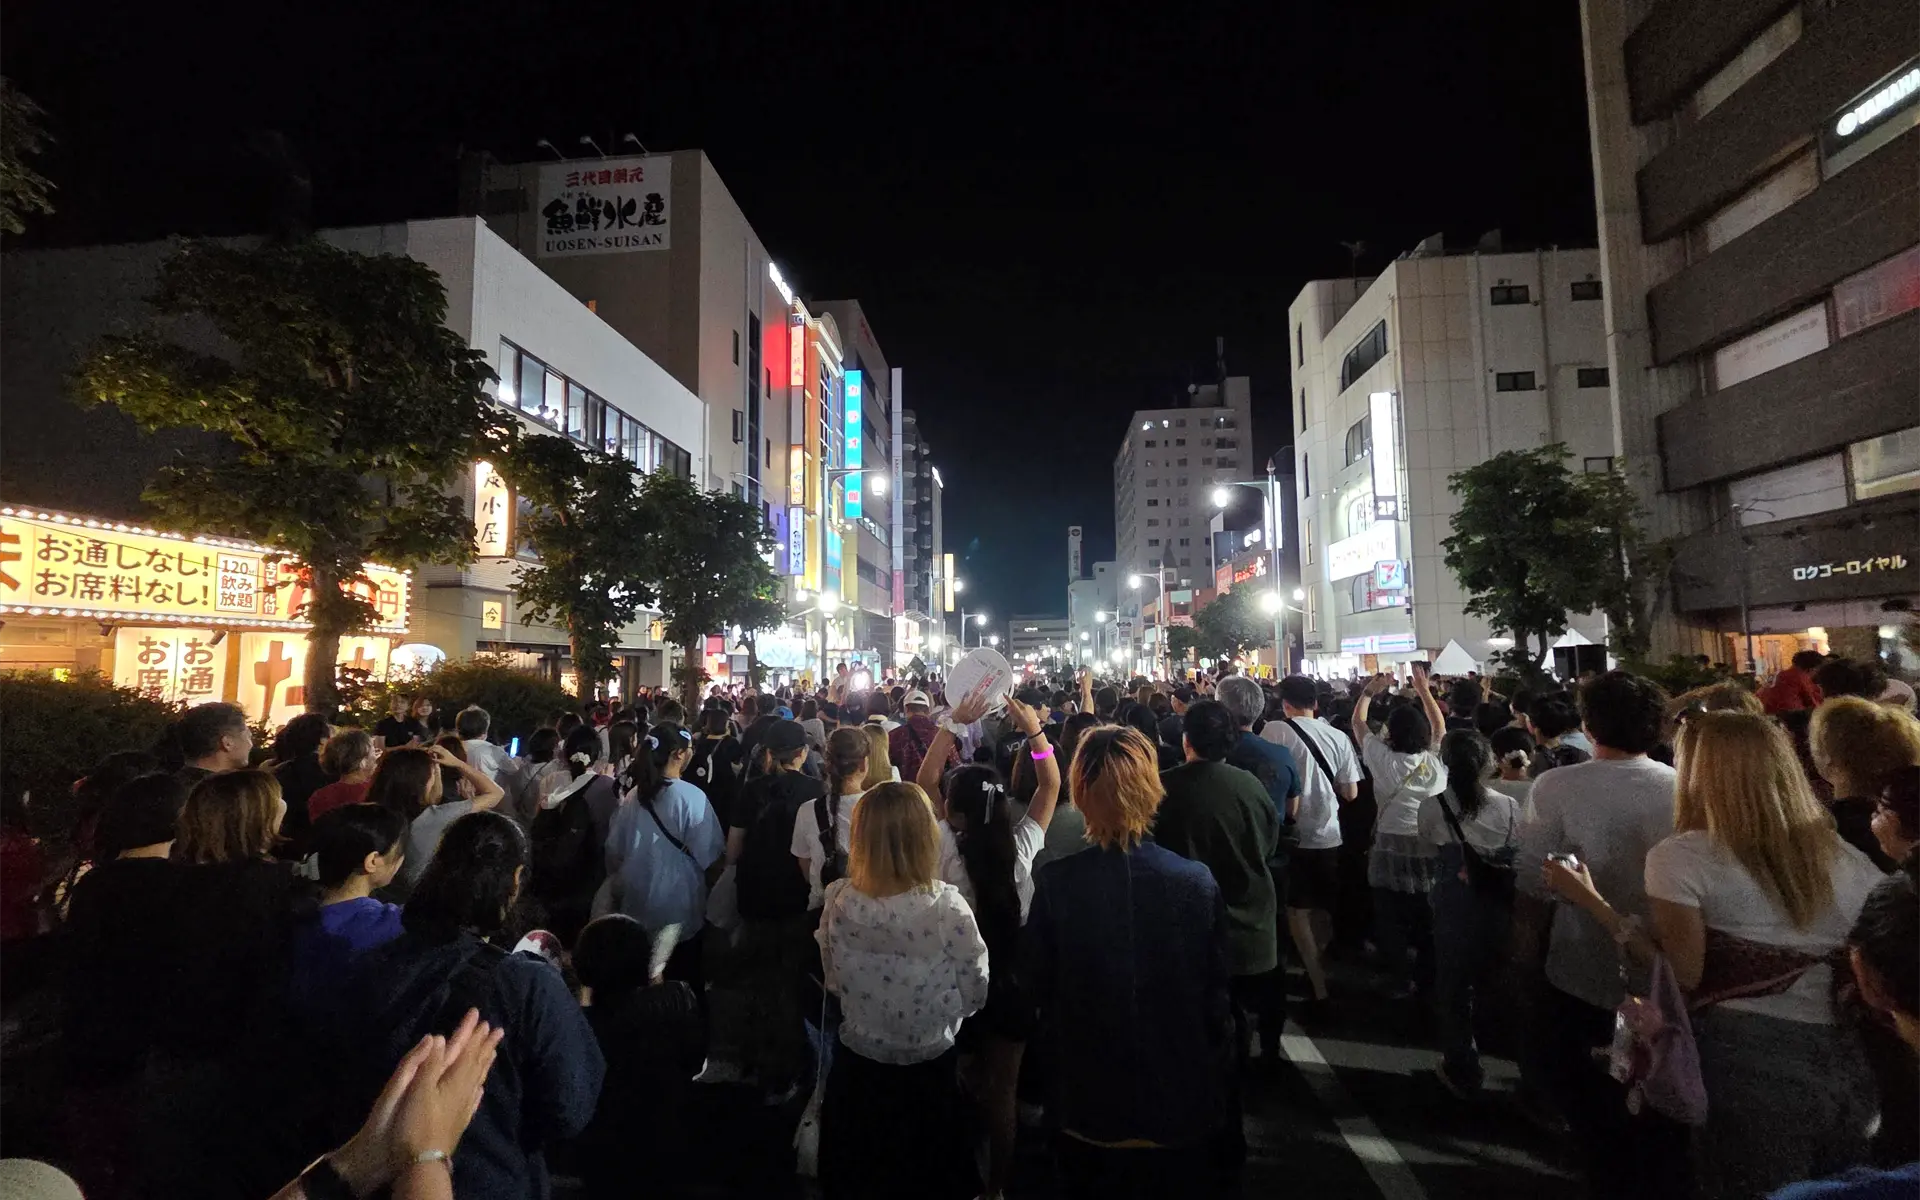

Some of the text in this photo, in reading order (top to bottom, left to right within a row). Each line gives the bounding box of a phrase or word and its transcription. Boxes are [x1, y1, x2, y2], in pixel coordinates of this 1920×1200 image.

[545, 233, 663, 252] UOSEN-SUISAN
[1793, 555, 1907, 581] ロクゴーロイヤル
[221, 575, 252, 591] 飲み
[220, 591, 252, 608] 放題
